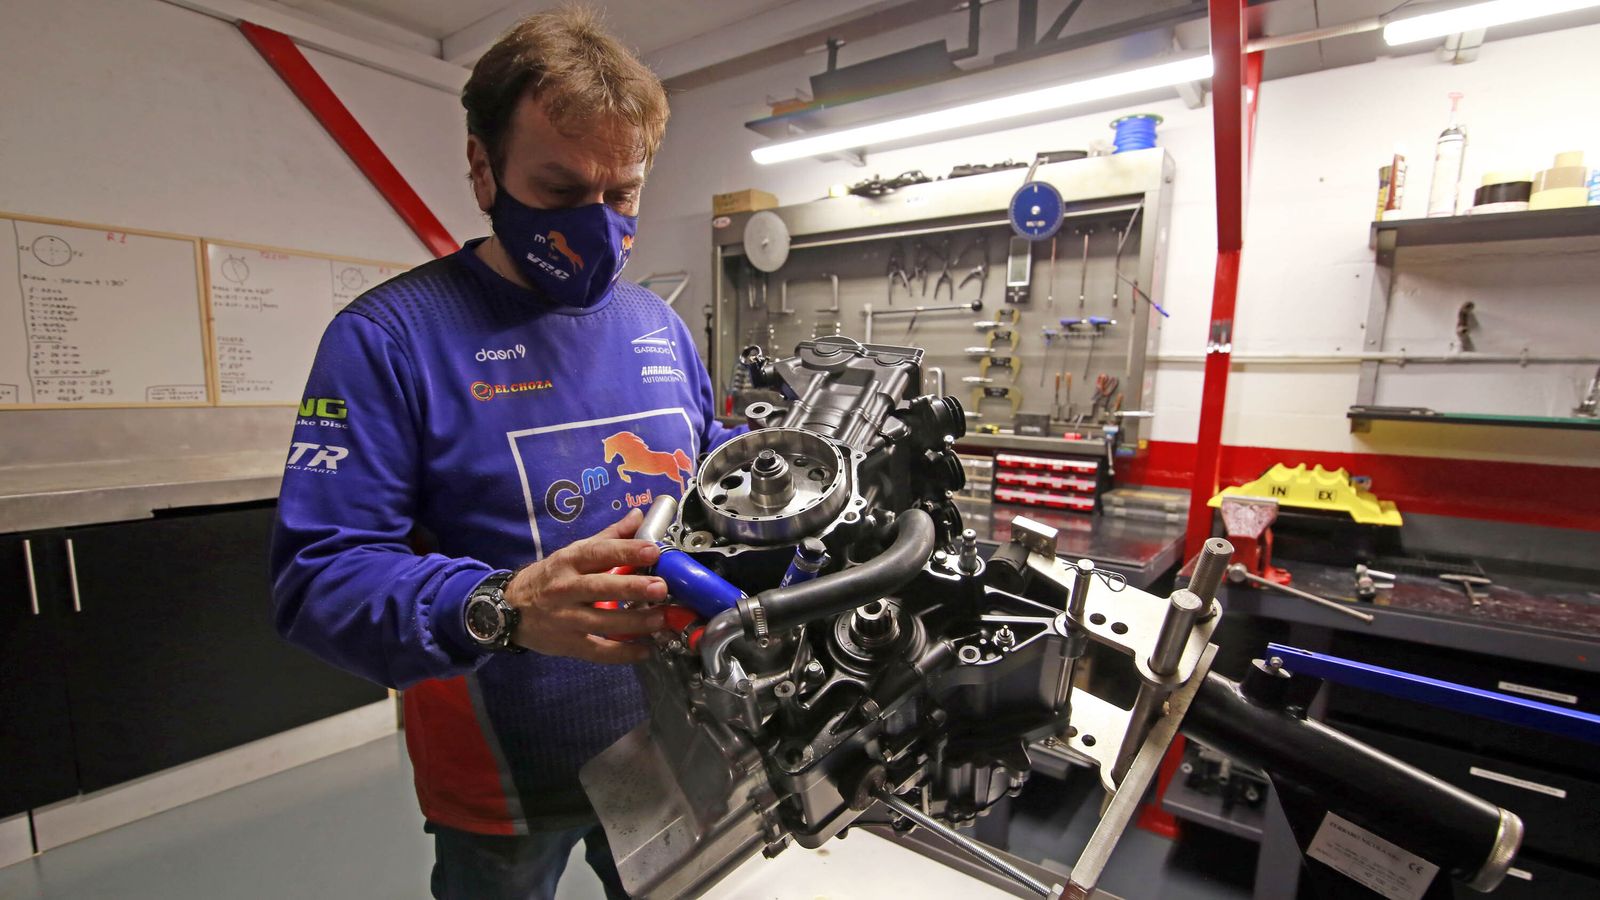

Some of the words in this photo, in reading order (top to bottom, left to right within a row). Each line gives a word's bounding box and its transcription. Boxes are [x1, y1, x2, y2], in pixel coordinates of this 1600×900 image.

[494, 383, 510, 394] EL
[511, 380, 553, 393] CHOZA
[303, 467, 338, 475] PARTS
[1271, 486, 1287, 496] IN
[1318, 490, 1334, 501] EX
